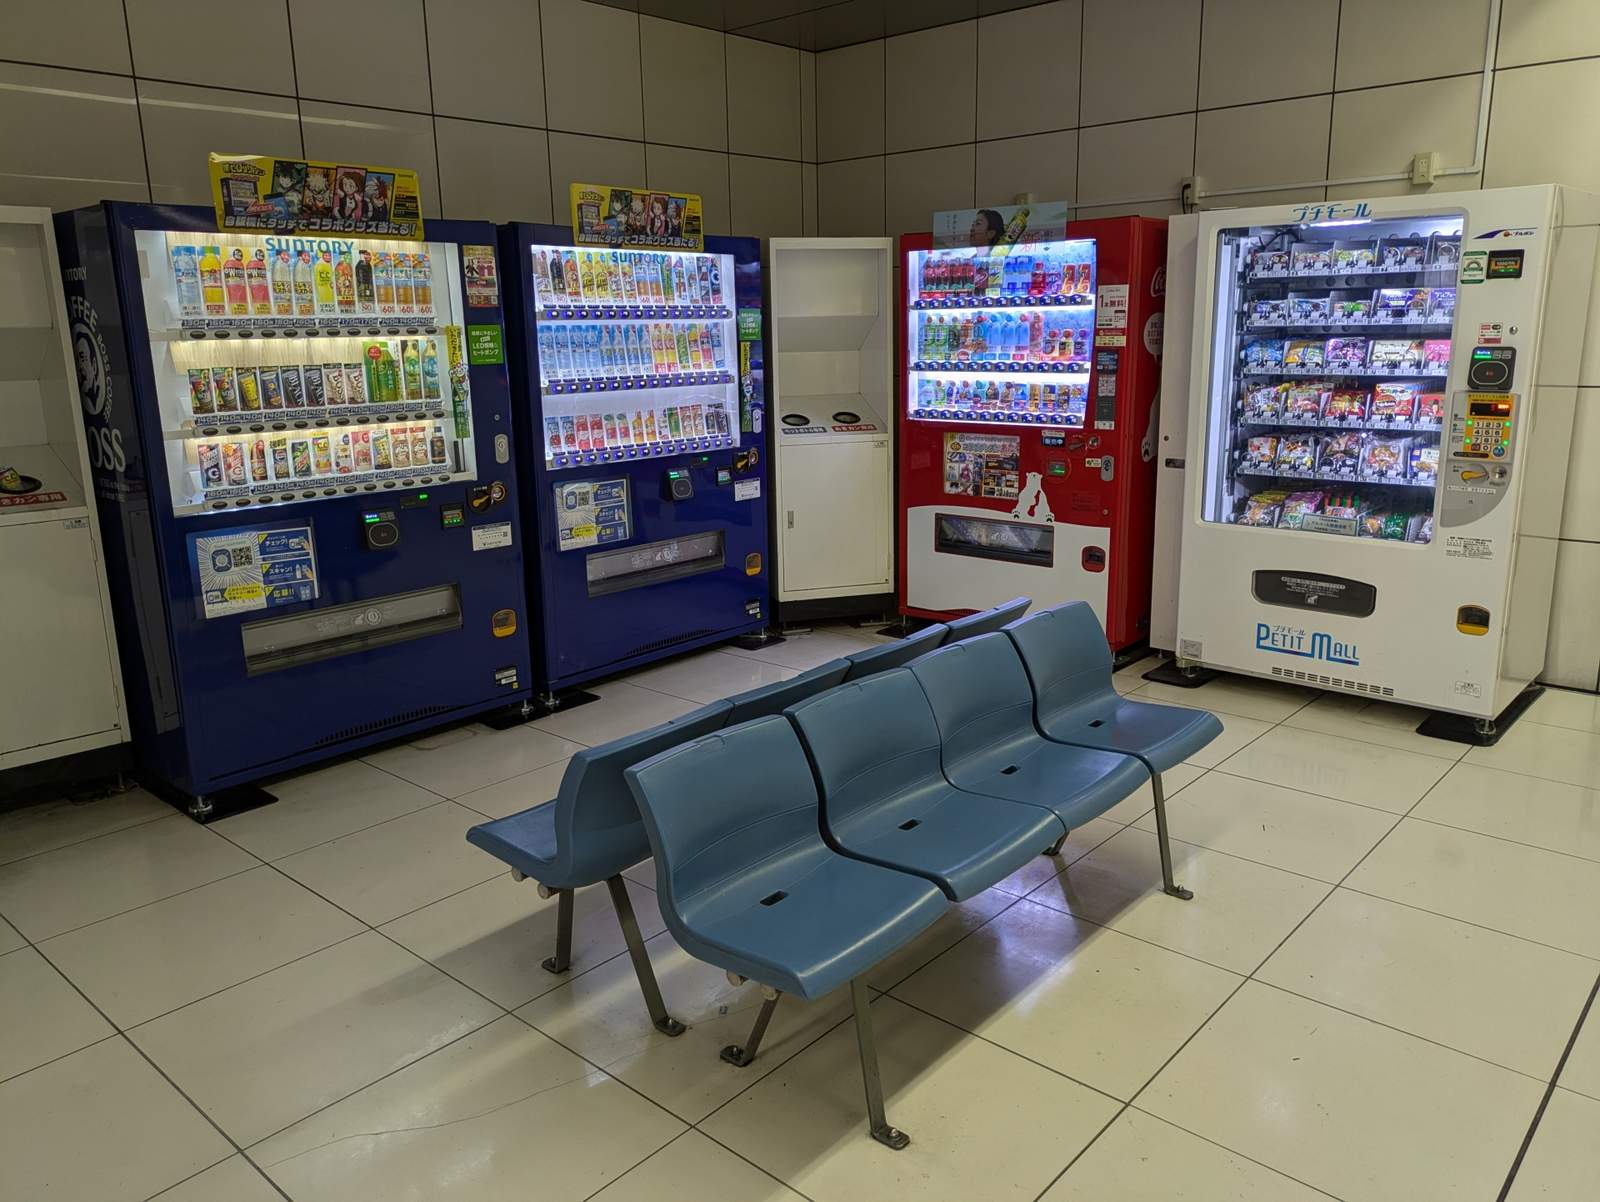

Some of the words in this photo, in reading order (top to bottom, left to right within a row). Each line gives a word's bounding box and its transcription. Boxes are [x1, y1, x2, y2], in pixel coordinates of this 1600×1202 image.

[1293, 203, 1372, 222] プチモール
[1256, 622, 1305, 651] PETIT
[1310, 632, 1360, 661] MALL
